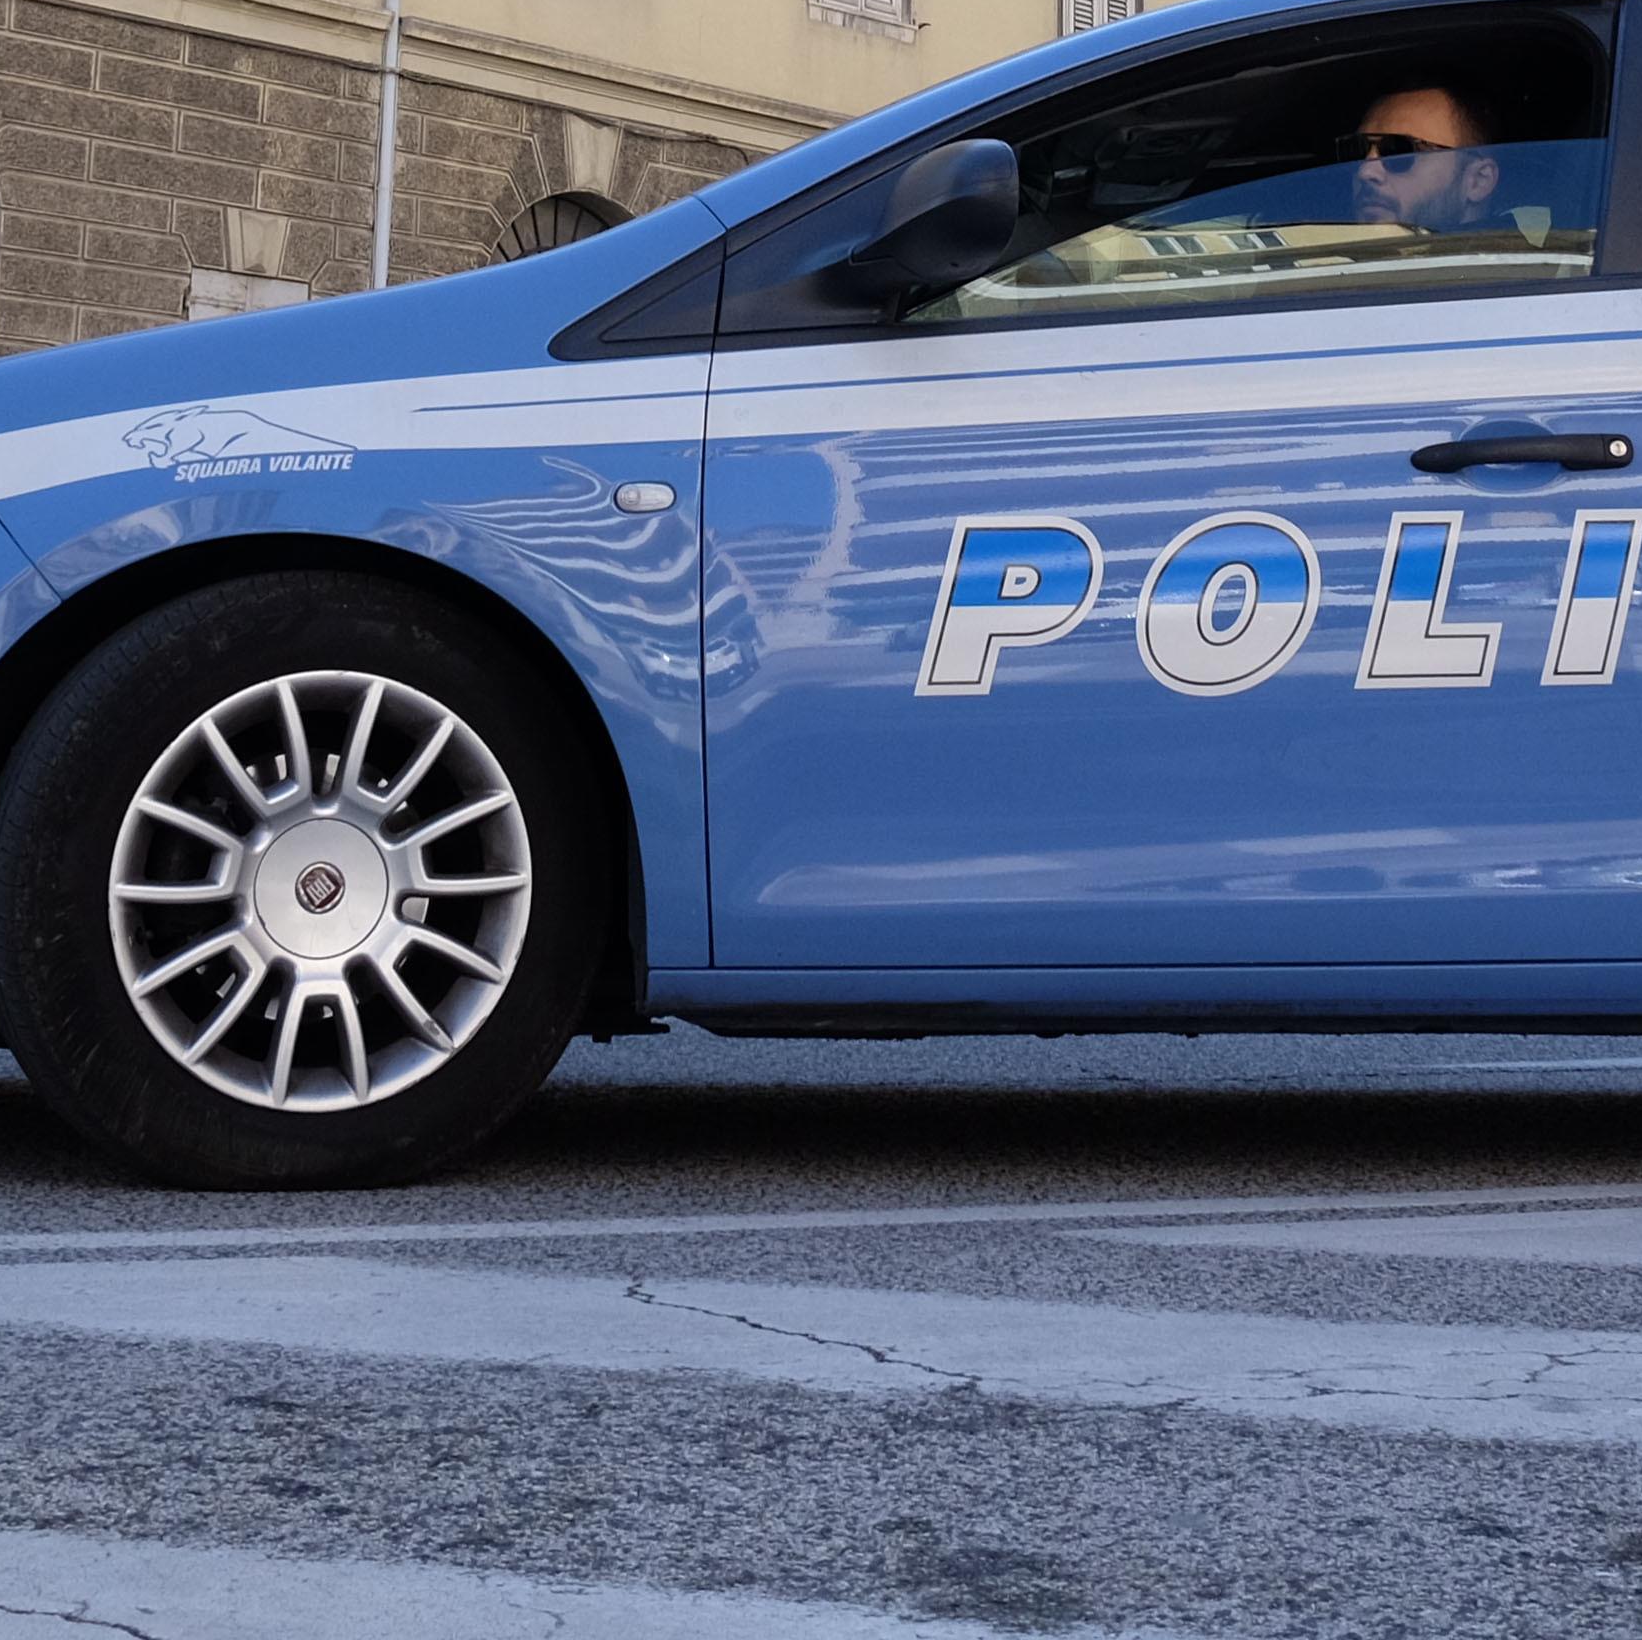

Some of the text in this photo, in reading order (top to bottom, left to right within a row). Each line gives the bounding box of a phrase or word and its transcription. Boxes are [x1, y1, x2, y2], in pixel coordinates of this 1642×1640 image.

[174, 453, 354, 482] SQUADRA VOLANTE
[305, 873, 336, 905] FIAT
